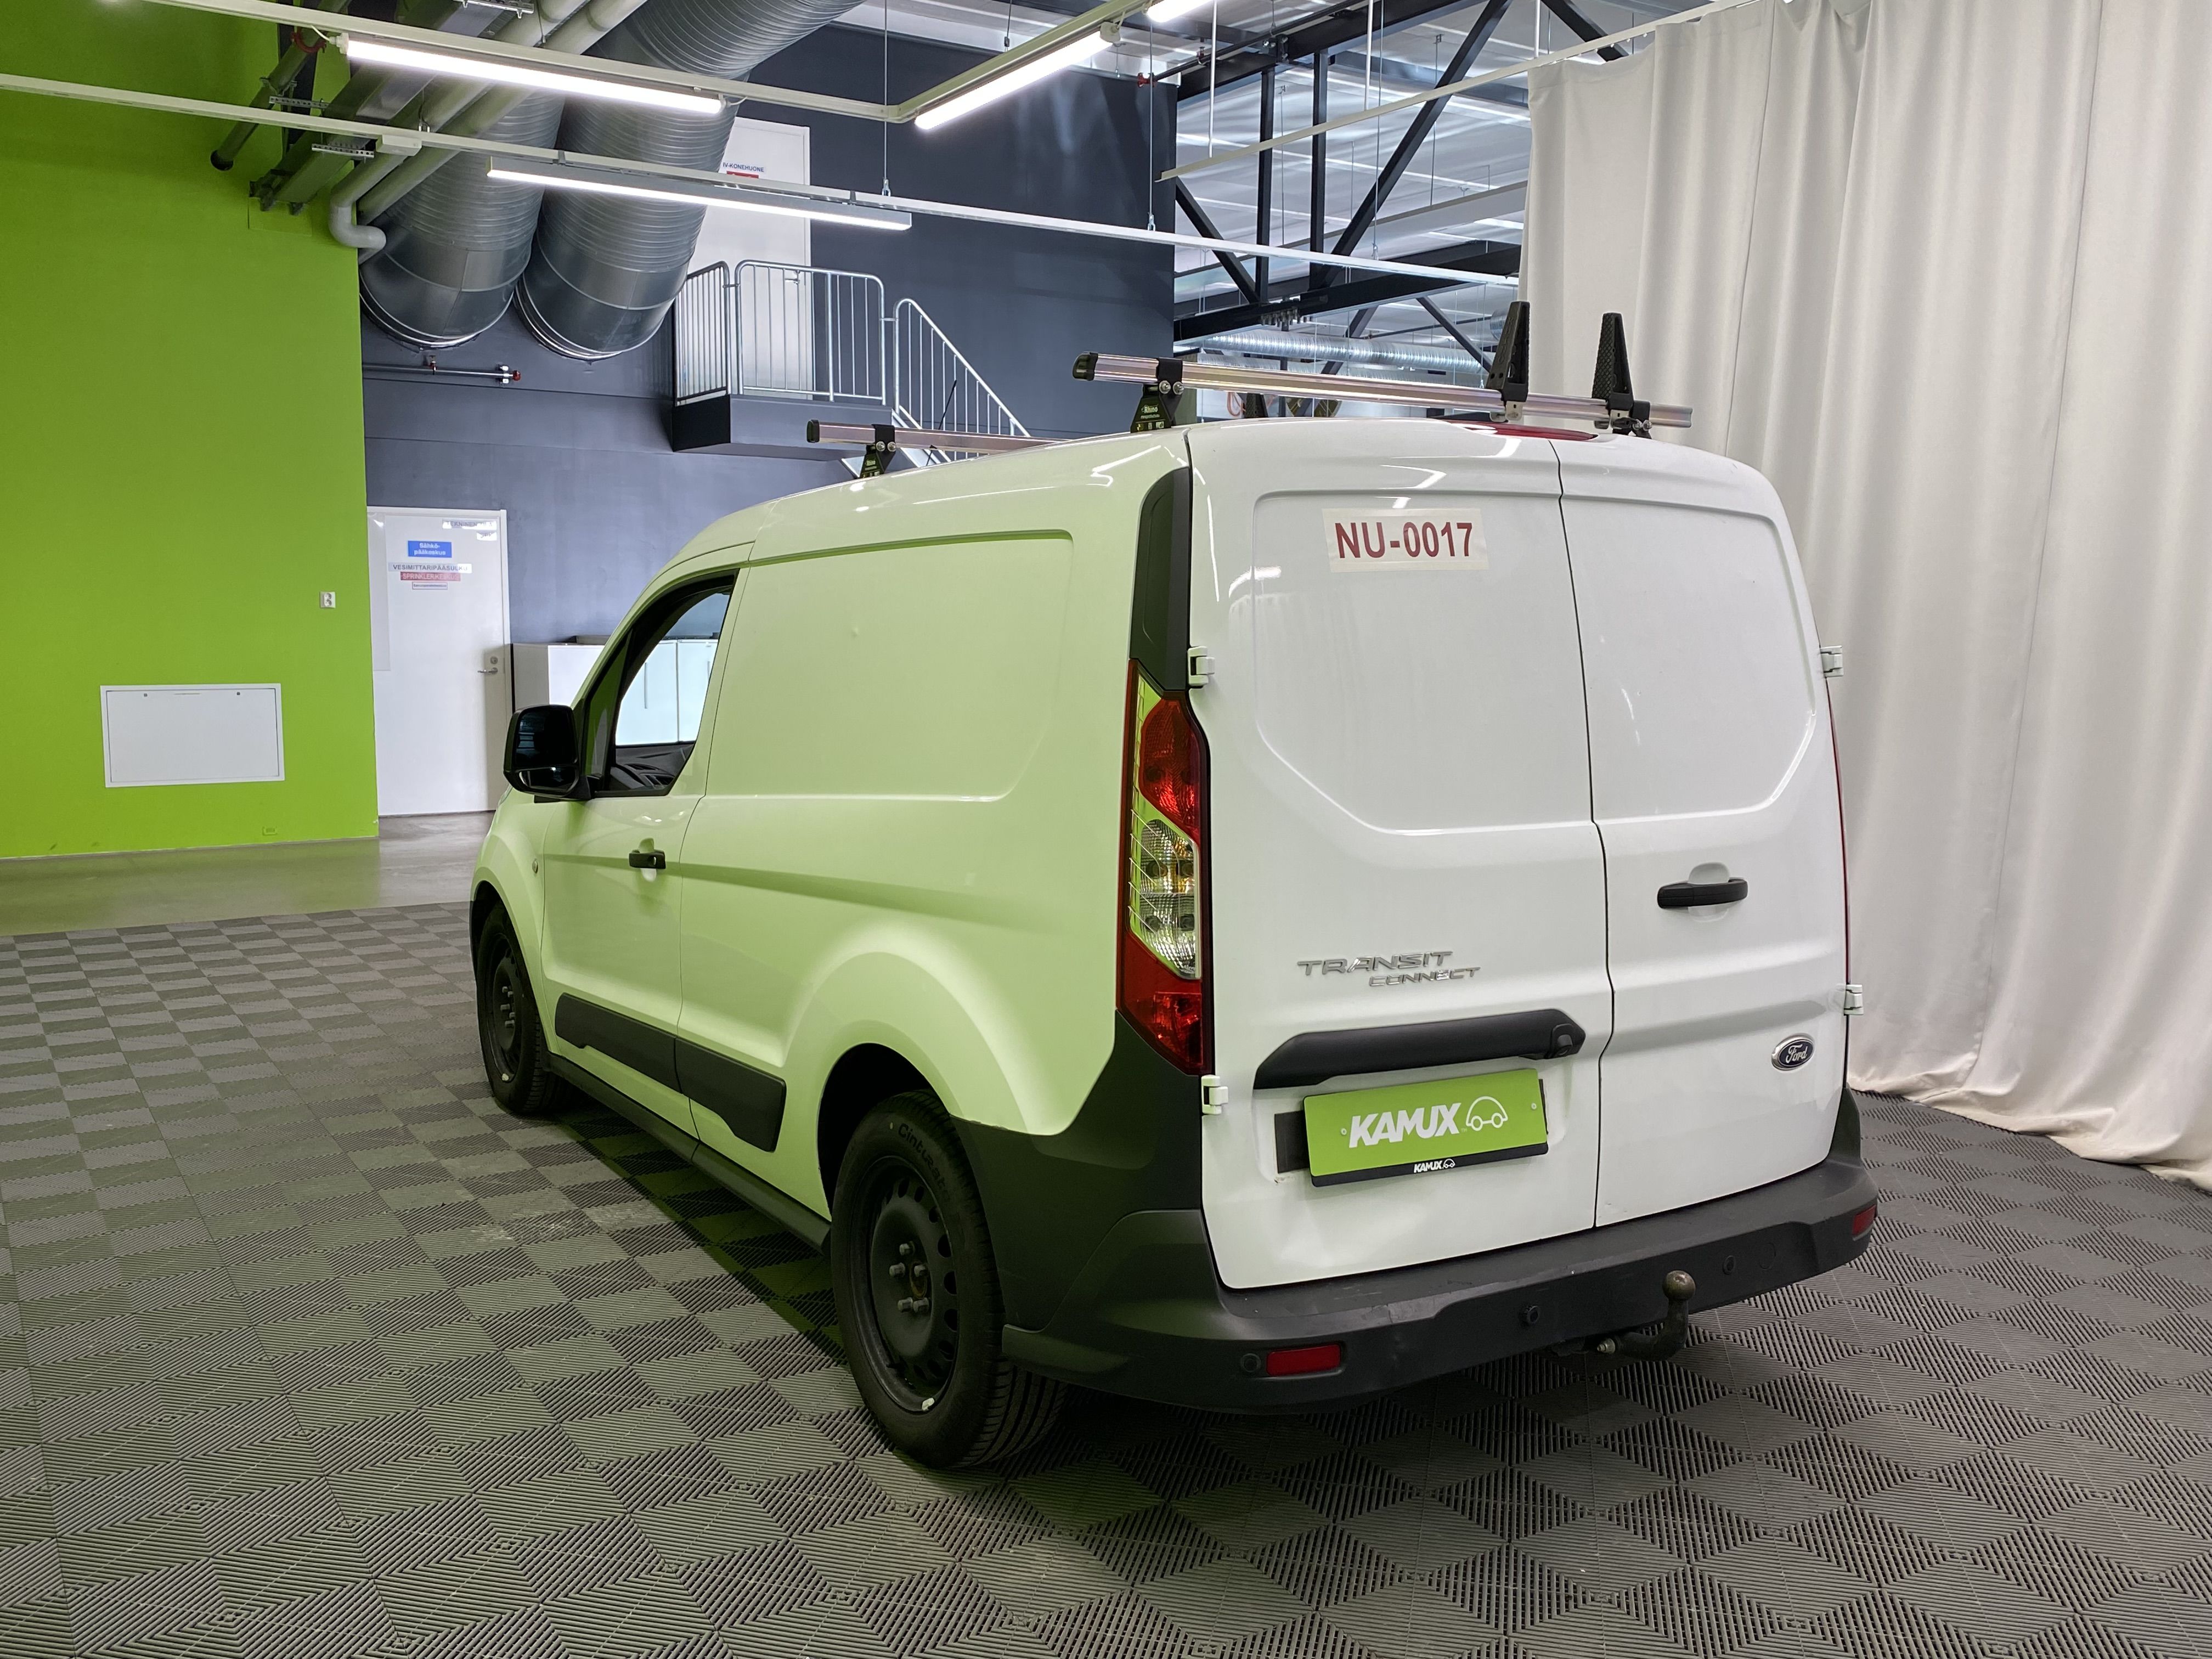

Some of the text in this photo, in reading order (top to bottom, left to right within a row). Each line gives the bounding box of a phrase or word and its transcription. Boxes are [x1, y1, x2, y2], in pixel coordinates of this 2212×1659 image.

[723, 162, 764, 172] IV-KONEHUONE
[1335, 522, 1472, 558] NU-0017
[1297, 951, 1453, 976] TRANSIT
[1369, 967, 1481, 986] CONNECT
[1786, 1044, 1808, 1063] Ford
[1349, 1102, 1462, 1148] KAMUX
[898, 1123, 951, 1202] Cinturato
[1413, 1160, 1443, 1173] KAMUX
